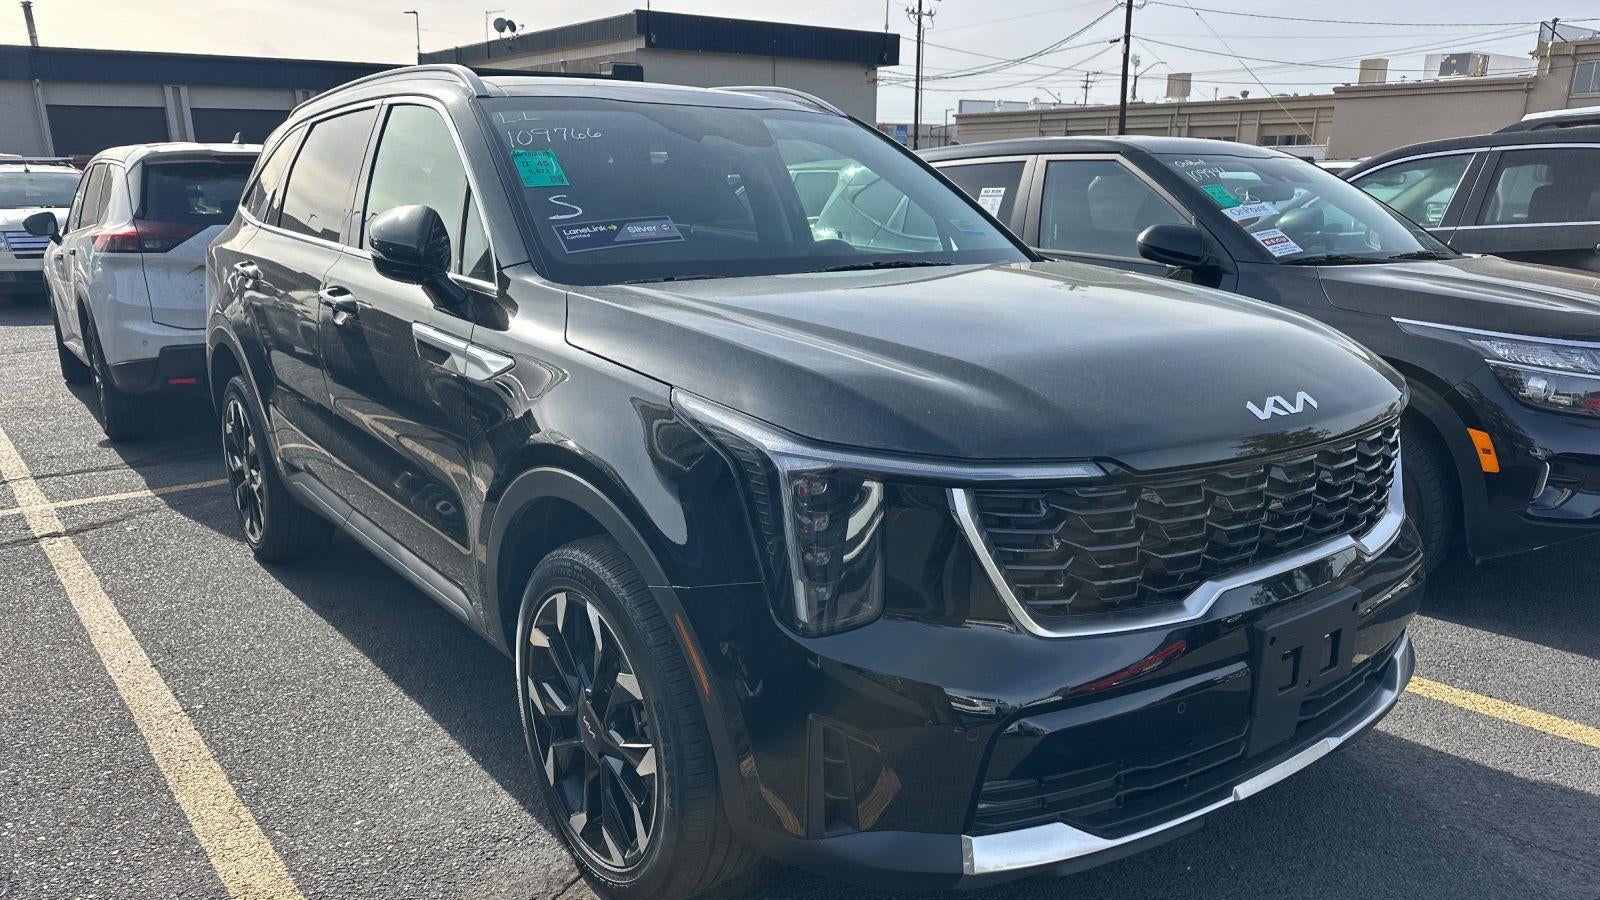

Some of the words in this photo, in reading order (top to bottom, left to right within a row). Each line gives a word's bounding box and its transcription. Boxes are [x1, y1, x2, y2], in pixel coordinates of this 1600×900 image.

[507, 127, 602, 148] 109766
[548, 194, 583, 219] S
[1229, 204, 1268, 216] OnPoint
[562, 225, 608, 236] LaneLink
[627, 223, 658, 234] Silver
[1246, 390, 1318, 420] KIA
